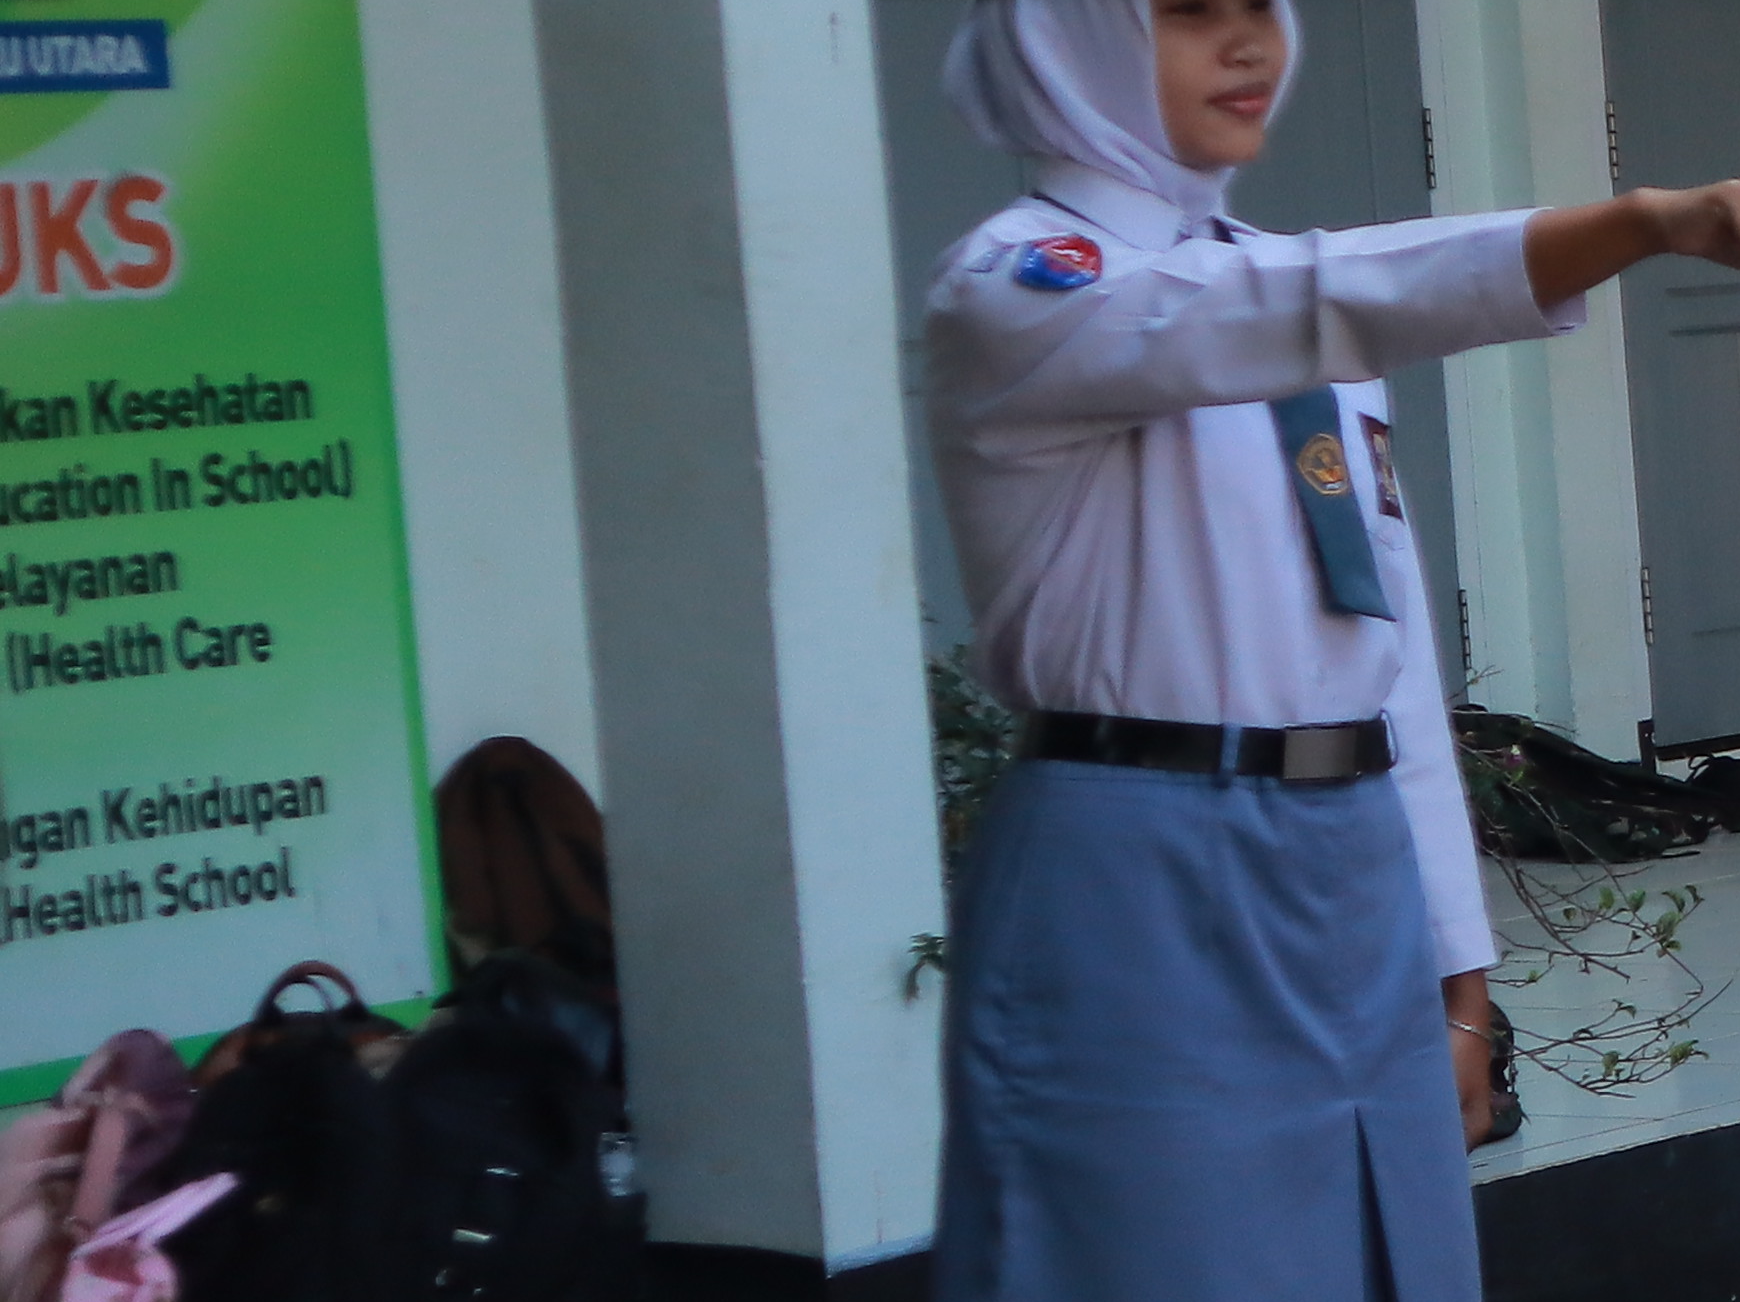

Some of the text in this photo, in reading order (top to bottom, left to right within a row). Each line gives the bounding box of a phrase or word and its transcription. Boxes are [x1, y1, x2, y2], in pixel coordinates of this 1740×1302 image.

[28, 34, 149, 76] UTARA
[87, 371, 313, 435] Kesehatan
[150, 456, 192, 512] In
[0, 550, 179, 617] layanan
[173, 615, 275, 670] Care
[102, 774, 329, 845] Kehidupan
[154, 846, 297, 917] School
